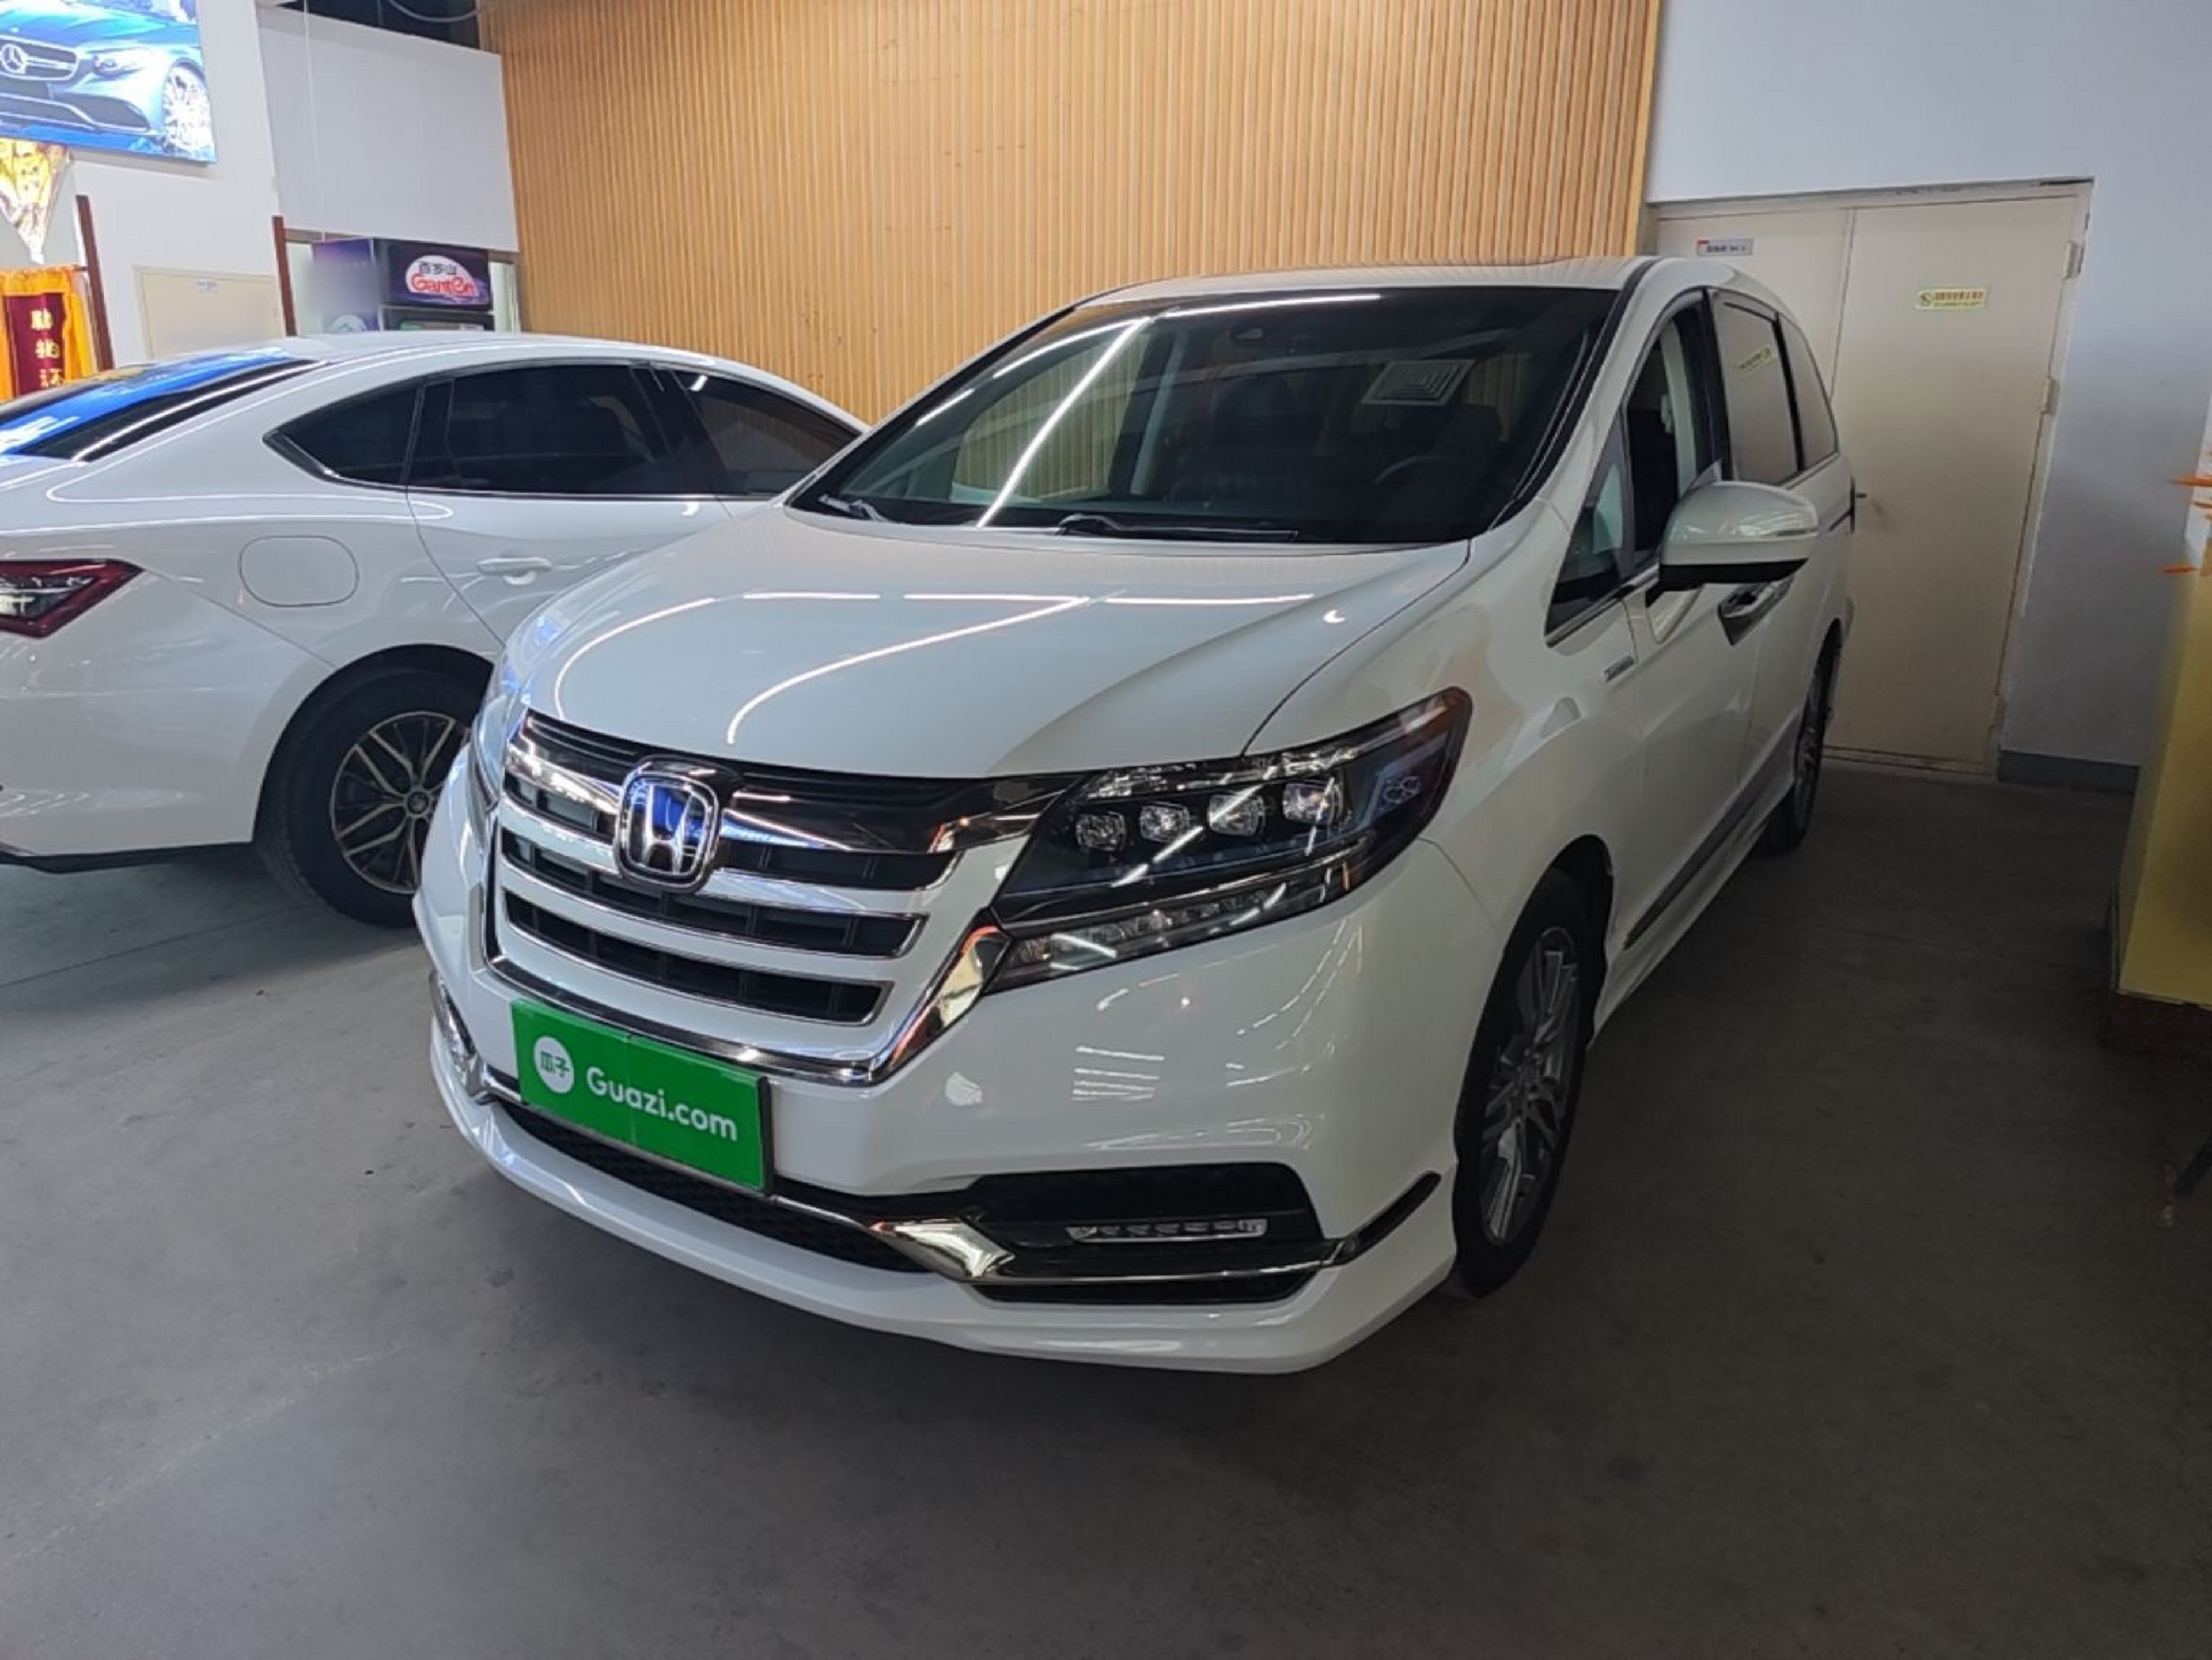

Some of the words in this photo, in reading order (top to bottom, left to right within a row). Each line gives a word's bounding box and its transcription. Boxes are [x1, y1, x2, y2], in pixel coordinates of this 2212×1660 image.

[419, 261, 457, 275] 百岁山
[540, 1052, 570, 1078] 瓜子
[586, 1066, 737, 1141] Guazi.com
